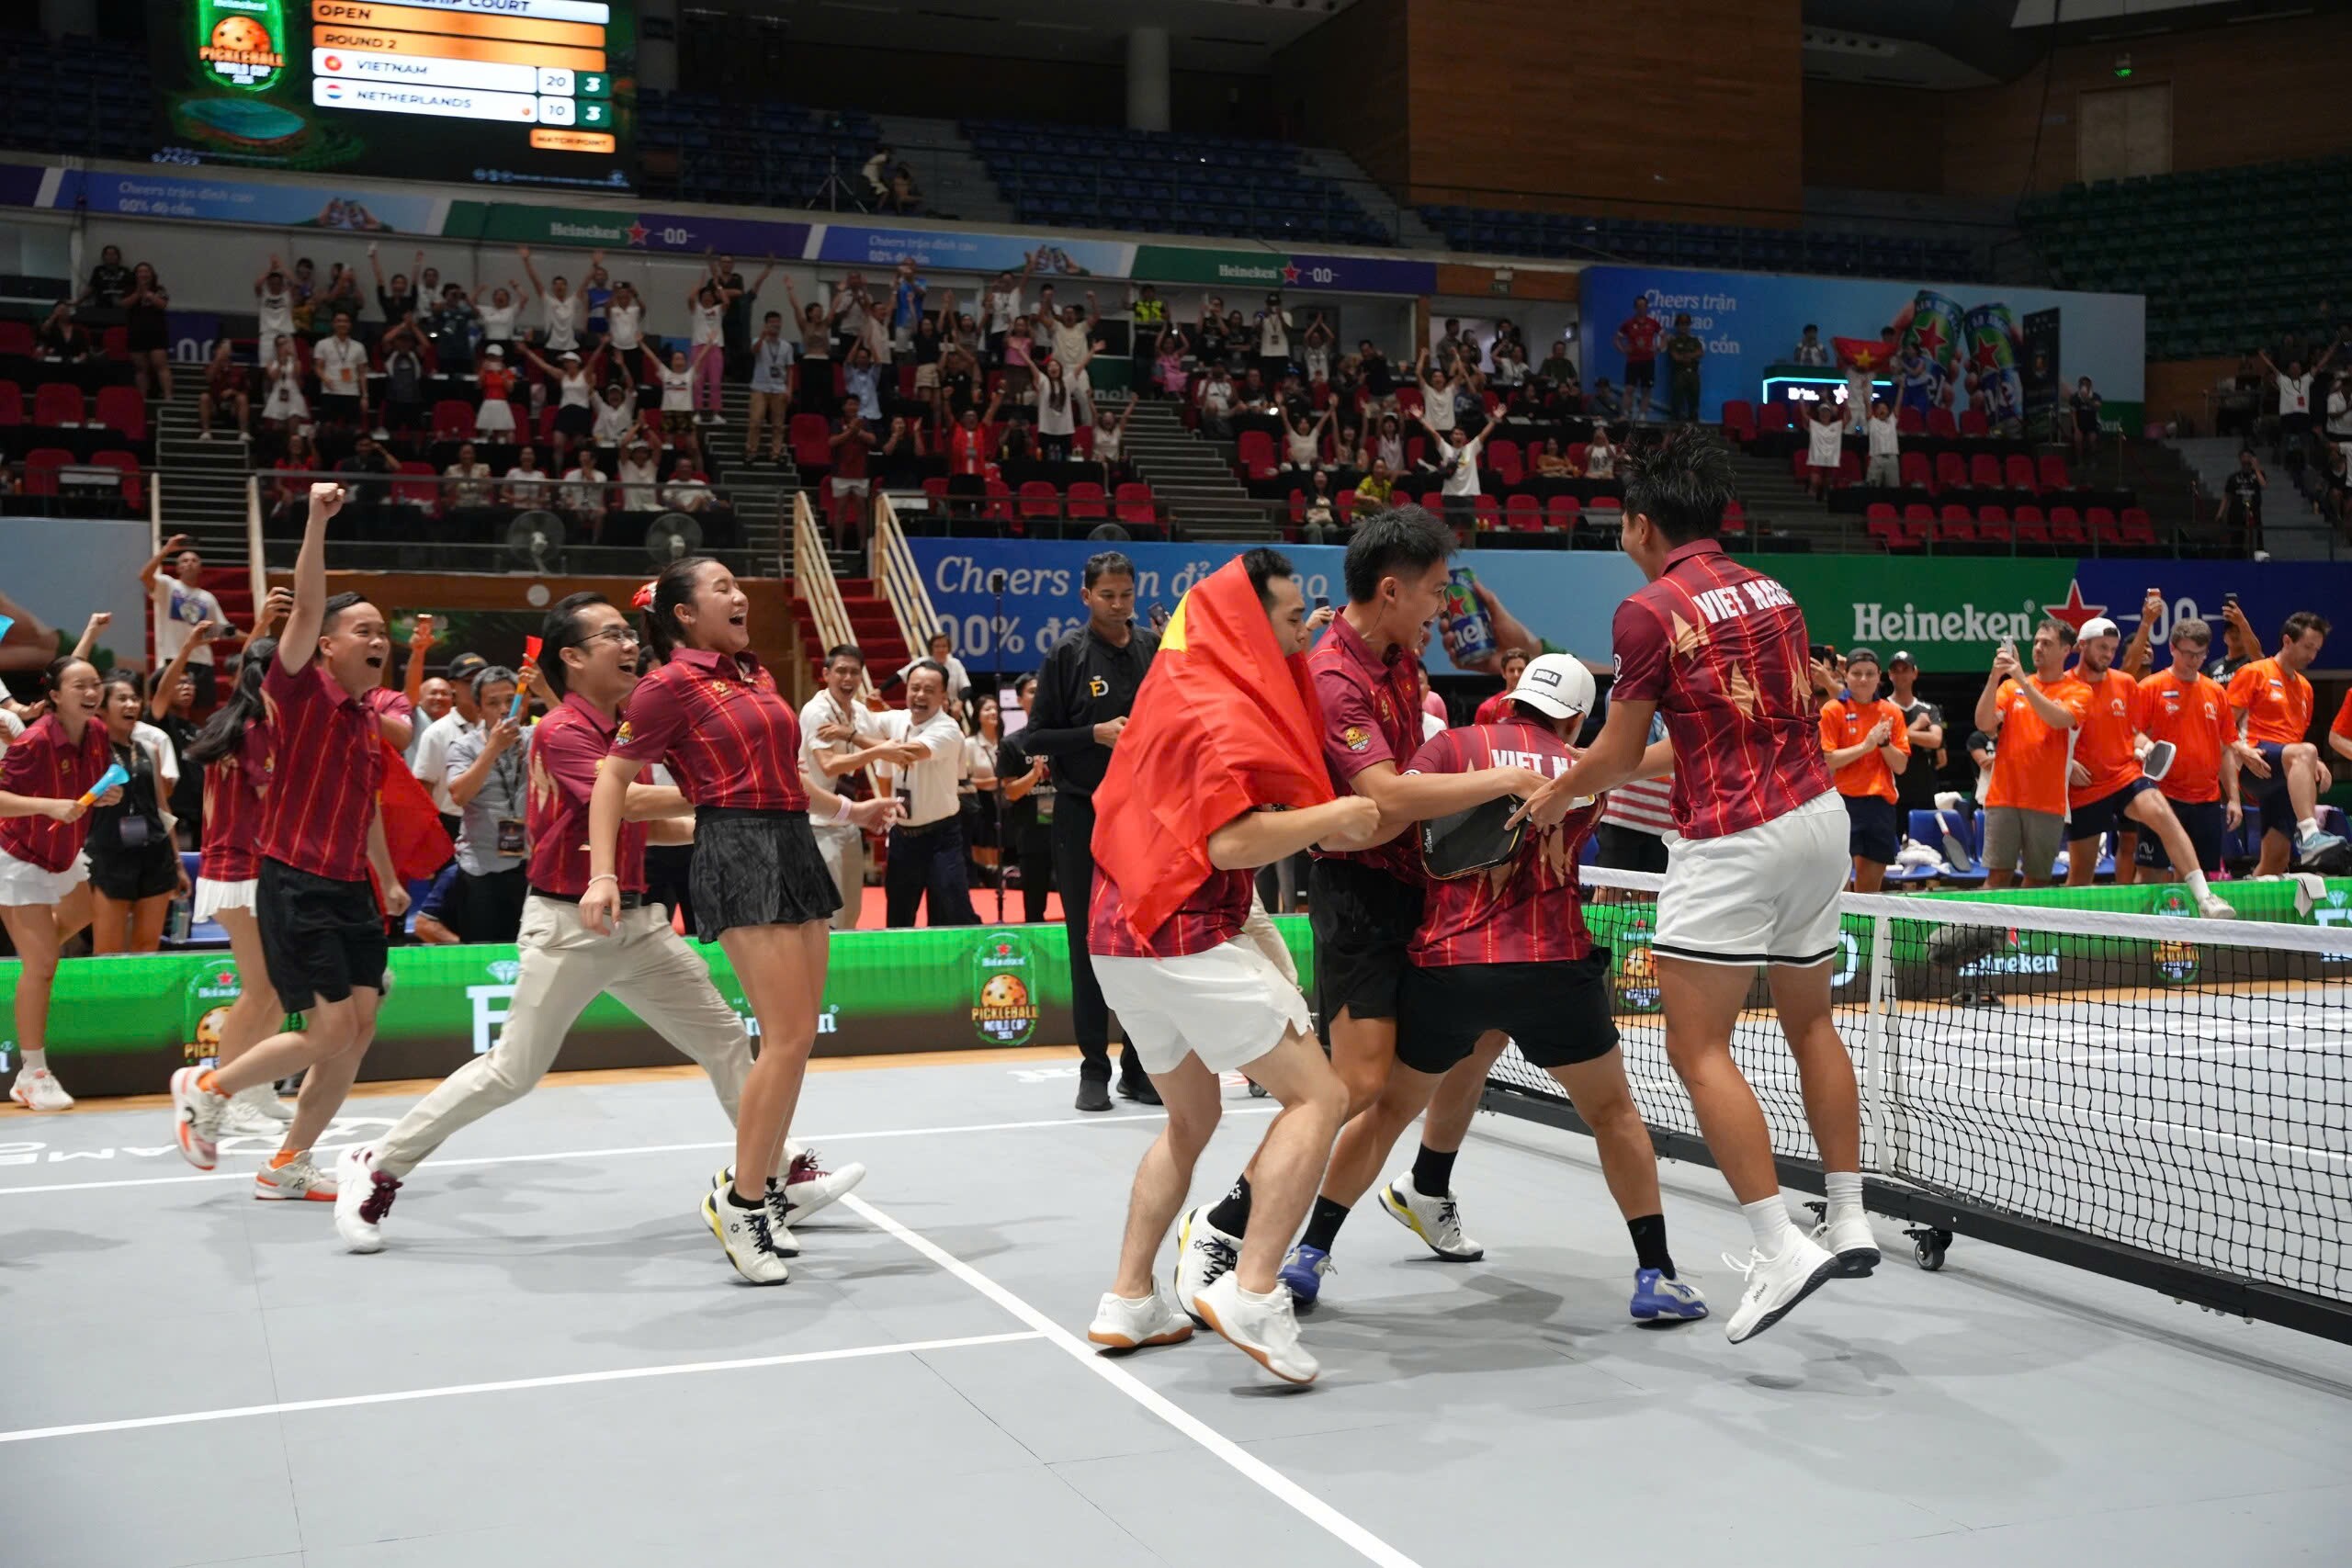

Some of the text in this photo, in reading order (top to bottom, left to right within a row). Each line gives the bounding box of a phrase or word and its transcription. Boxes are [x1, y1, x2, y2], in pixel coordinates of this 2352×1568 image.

[319, 6, 371, 20] OPEN
[324, 34, 397, 50] ROUND 2
[356, 60, 601, 92] VIETNAM 20 3
[356, 90, 601, 121] NETHERLANDS 10 3
[550, 222, 621, 240] Heineken
[1218, 264, 1277, 279] Heineken
[1645, 288, 1736, 315] Cheers trận
[935, 556, 1070, 597] Cheers
[1290, 573, 1329, 598] ao
[1691, 586, 1748, 624] VIET
[1852, 603, 2033, 642] Heineken
[1490, 749, 1577, 780] VIET N
